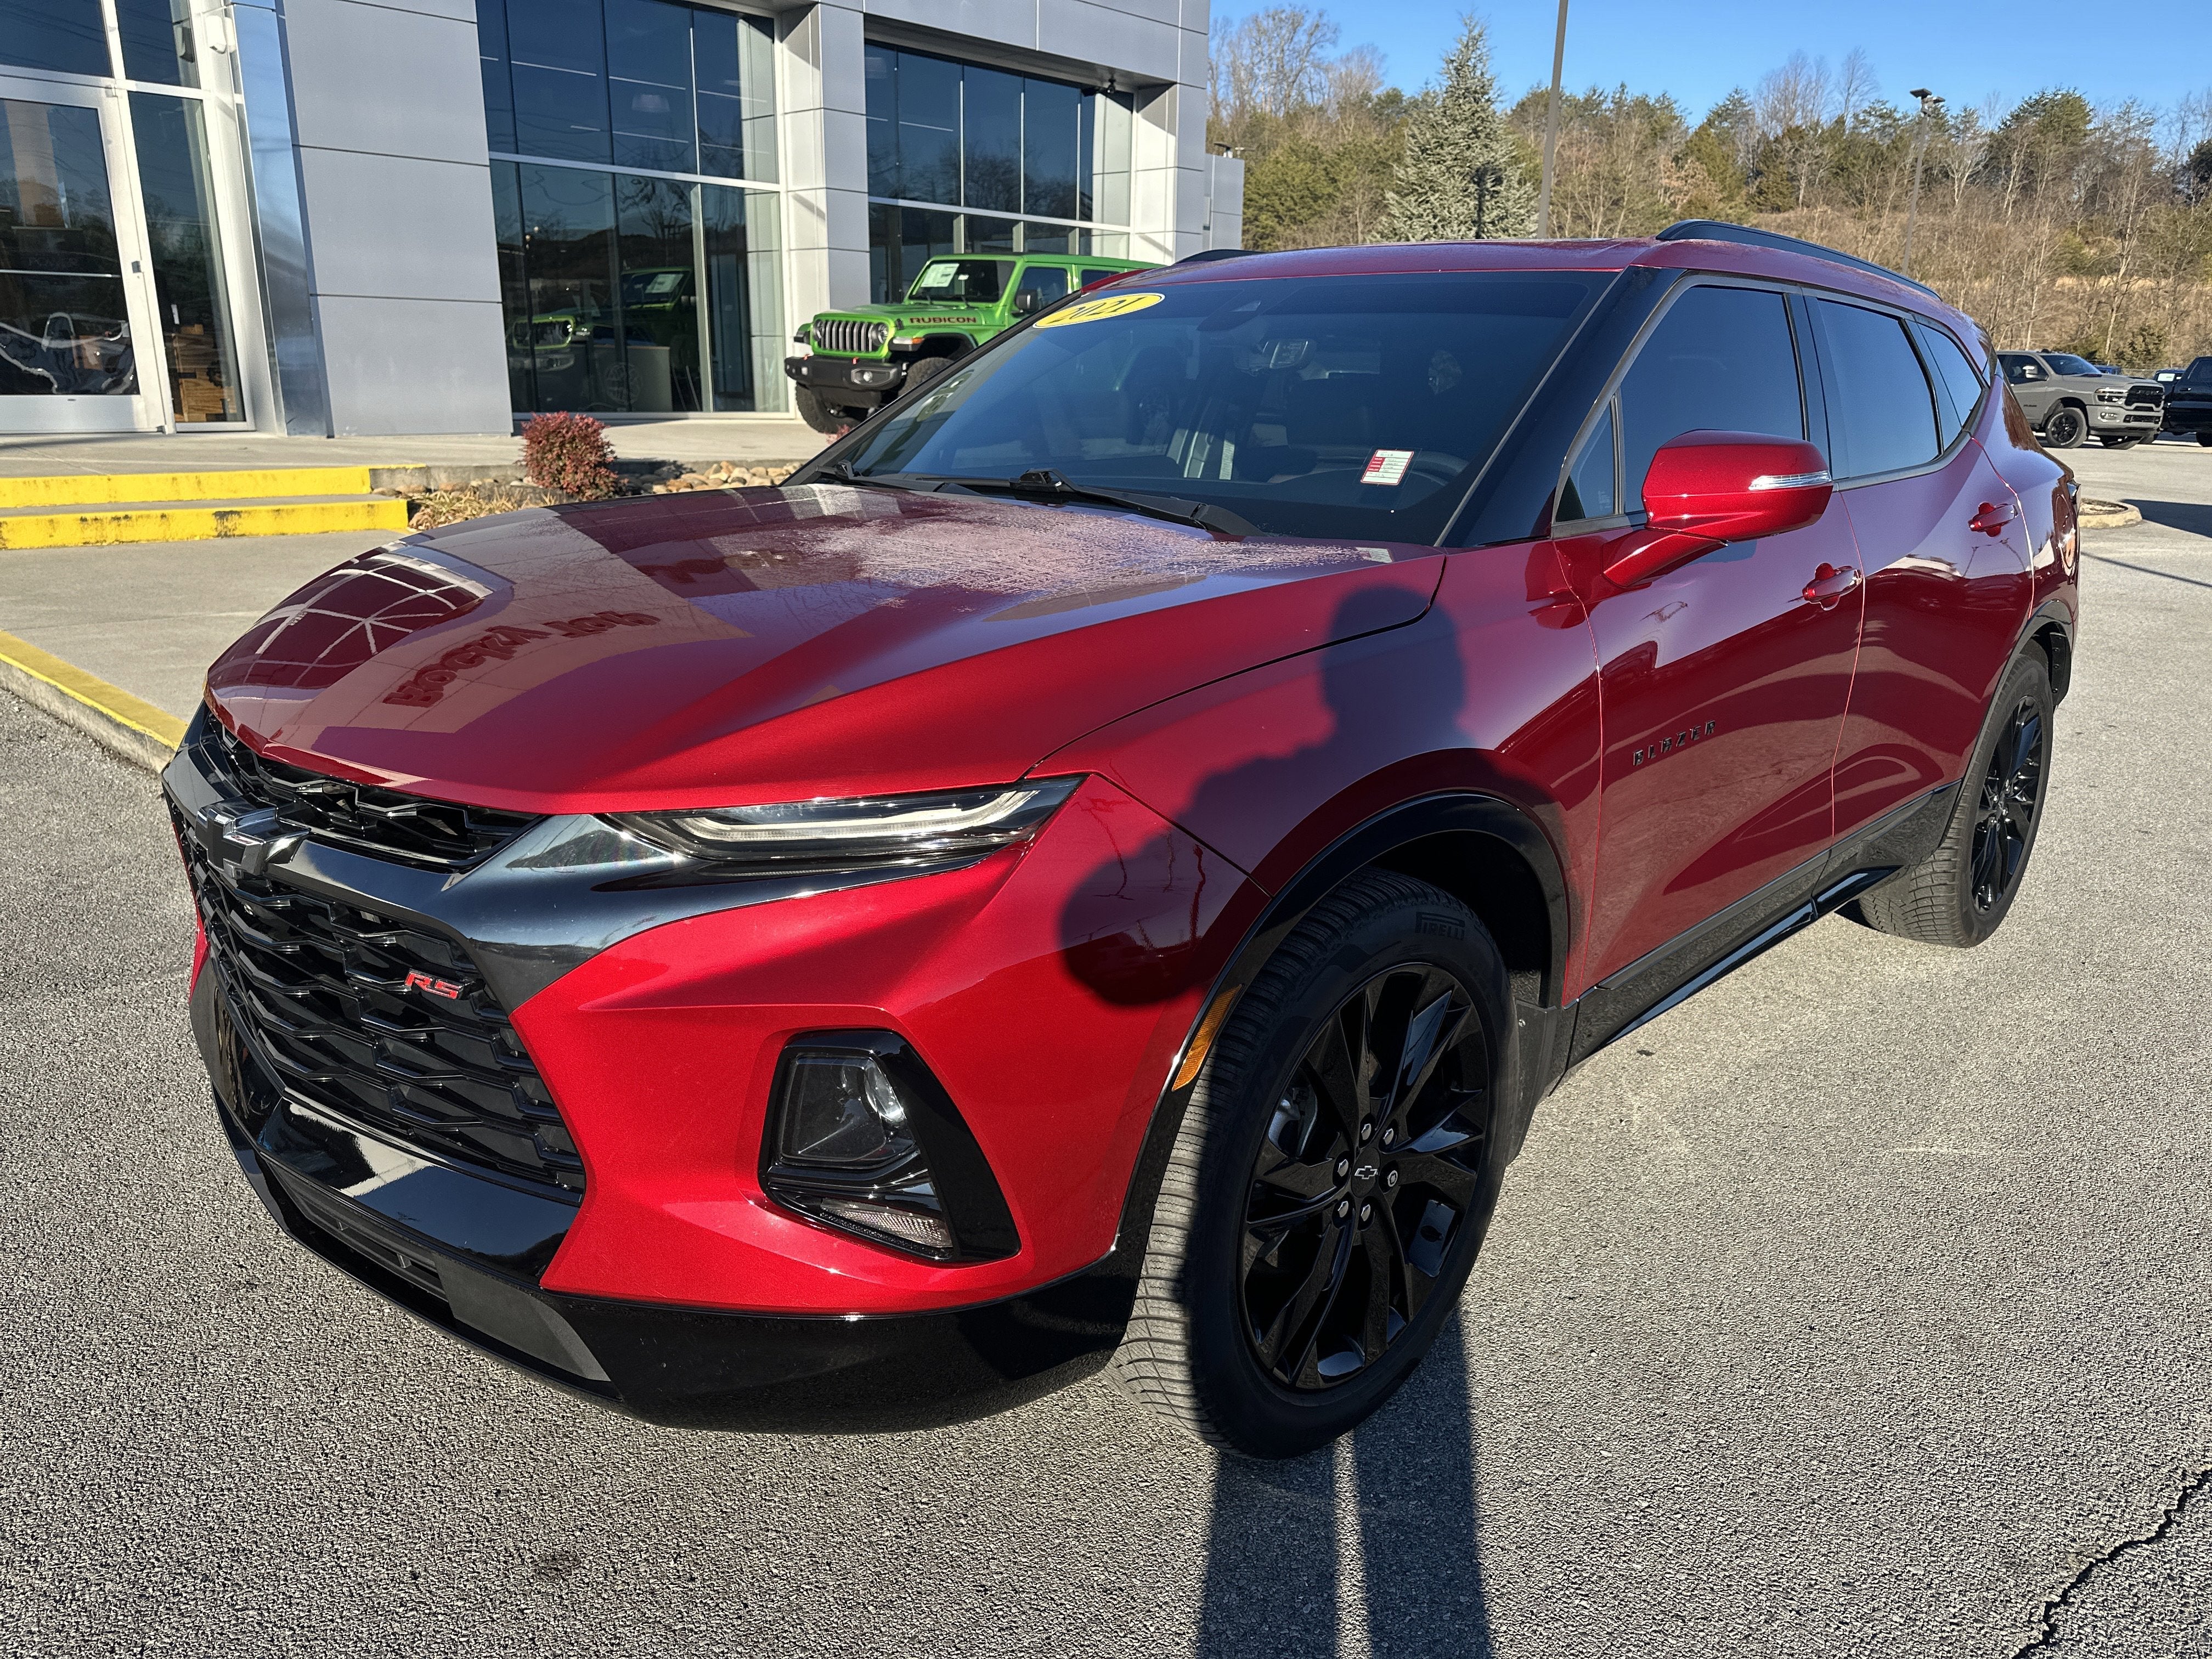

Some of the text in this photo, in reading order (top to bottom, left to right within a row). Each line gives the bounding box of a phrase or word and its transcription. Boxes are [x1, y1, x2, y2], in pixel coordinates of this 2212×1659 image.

[1046, 296, 1147, 325] 2021
[1633, 719, 1716, 766] BLAZER
[1415, 912, 1465, 940] PIRELLI
[404, 971, 460, 1000] RS
